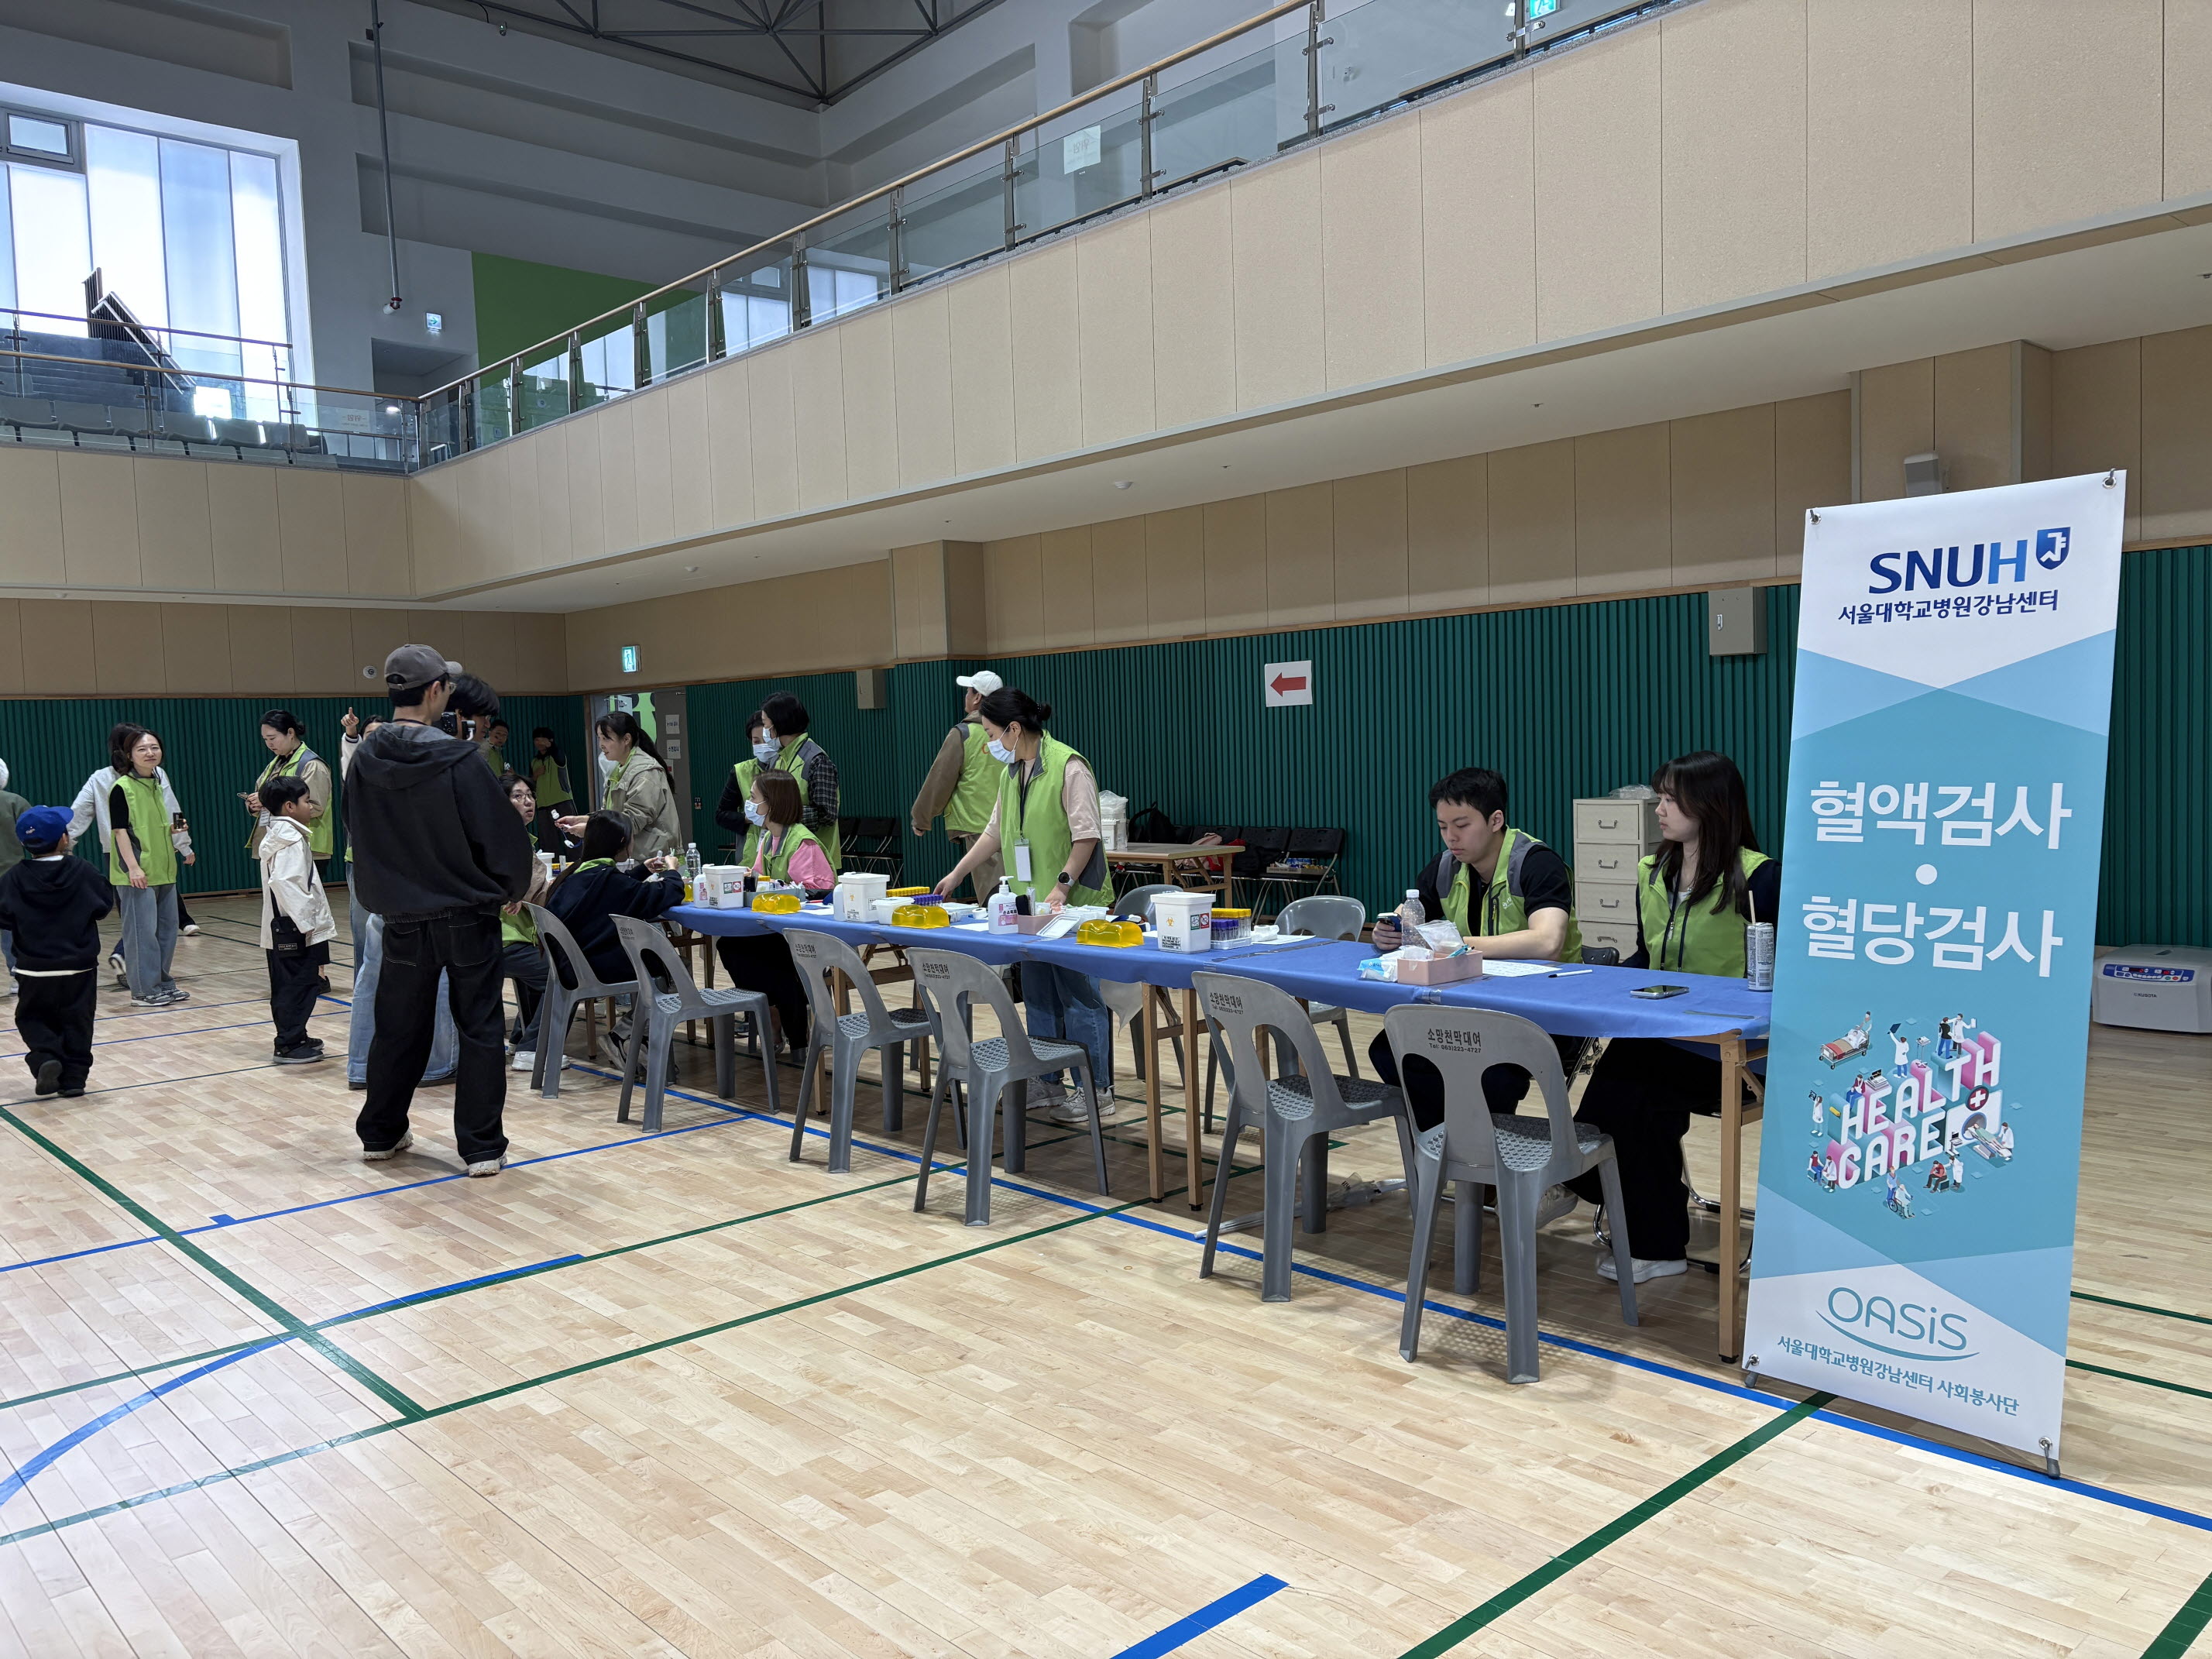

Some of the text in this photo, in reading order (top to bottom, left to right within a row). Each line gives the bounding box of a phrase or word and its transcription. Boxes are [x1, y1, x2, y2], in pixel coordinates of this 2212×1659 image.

[1868, 540, 2028, 594] SNUH
[1838, 589, 2059, 625] 서울대학교병원강남센터
[1810, 781, 2073, 850] 혈액검사
[1802, 895, 2063, 977] 혈당검사
[1210, 991, 1243, 1009] 소망천막대여
[1427, 1028, 1482, 1047] 소망천막대여
[1441, 1044, 1482, 1053] 063)223-4727
[1841, 1041, 2001, 1146] HEALTH
[1839, 1110, 1946, 1190] CARE
[1778, 1336, 2020, 1417] 서울대학교병원강남센터 사회봉사단
